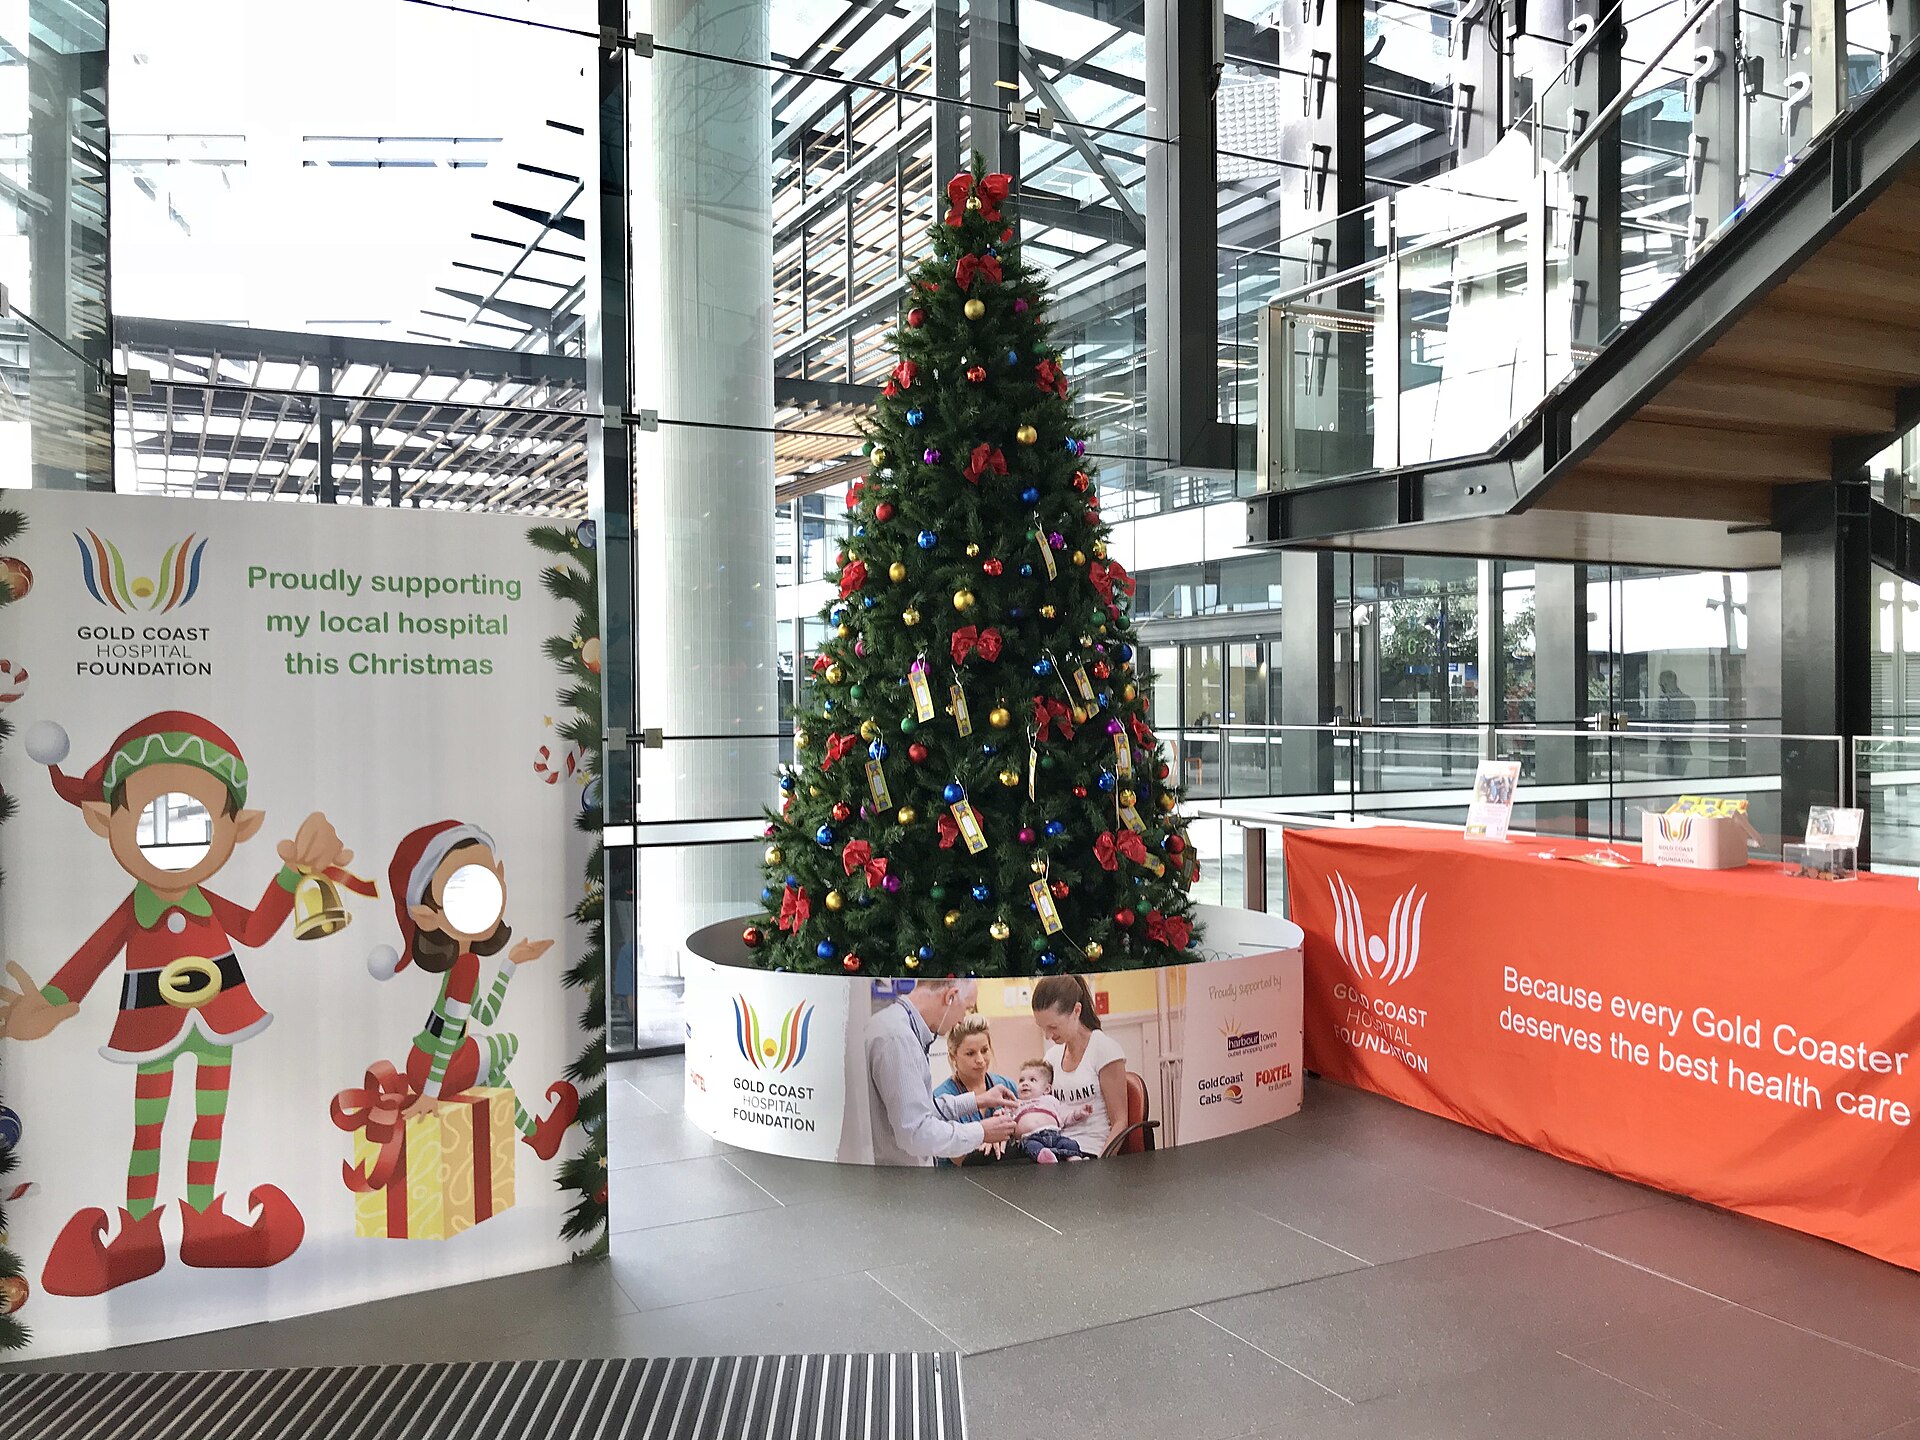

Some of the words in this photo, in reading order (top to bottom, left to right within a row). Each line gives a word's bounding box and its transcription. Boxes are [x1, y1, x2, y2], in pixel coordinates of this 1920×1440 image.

[248, 566, 362, 597] Proudly
[371, 574, 522, 601] supporting
[77, 626, 135, 640] GOLD
[142, 627, 210, 641] COAST
[266, 614, 310, 637] my
[320, 610, 389, 633] local
[398, 612, 508, 640] hospital
[97, 644, 192, 658] HOSPITAL
[76, 661, 212, 676] FOUNDATION
[284, 652, 339, 675] this
[348, 653, 494, 676] Christmas
[1208, 983, 1237, 1001] Proudly
[1239, 977, 1271, 996] supported
[1271, 975, 1281, 991] by
[1373, 999, 1427, 1028] COAST
[1503, 965, 1603, 1013] Because
[1610, 995, 1683, 1037] every
[1692, 1007, 1761, 1050] Gold
[1773, 1024, 1909, 1076] Coaster
[1228, 1034, 1259, 1050] harbour
[1260, 1031, 1278, 1042] town
[1333, 1024, 1428, 1074] FOUNDATION
[1256, 1063, 1292, 1087] FOXTEL
[1499, 1006, 1602, 1054] deserves
[1610, 1032, 1650, 1066] the
[1658, 1043, 1719, 1085] best
[1727, 1059, 1822, 1111] health
[1835, 1090, 1911, 1127] care
[733, 1077, 764, 1093] GOLD
[769, 1083, 815, 1100] COAST
[1069, 1084, 1096, 1101] JANE
[1198, 1078, 1219, 1091] Gold
[1220, 1072, 1244, 1087] Coast
[743, 1095, 801, 1115] HOSPITAL
[1199, 1092, 1222, 1106] Cabs
[733, 1107, 815, 1132] FOUNDATION
